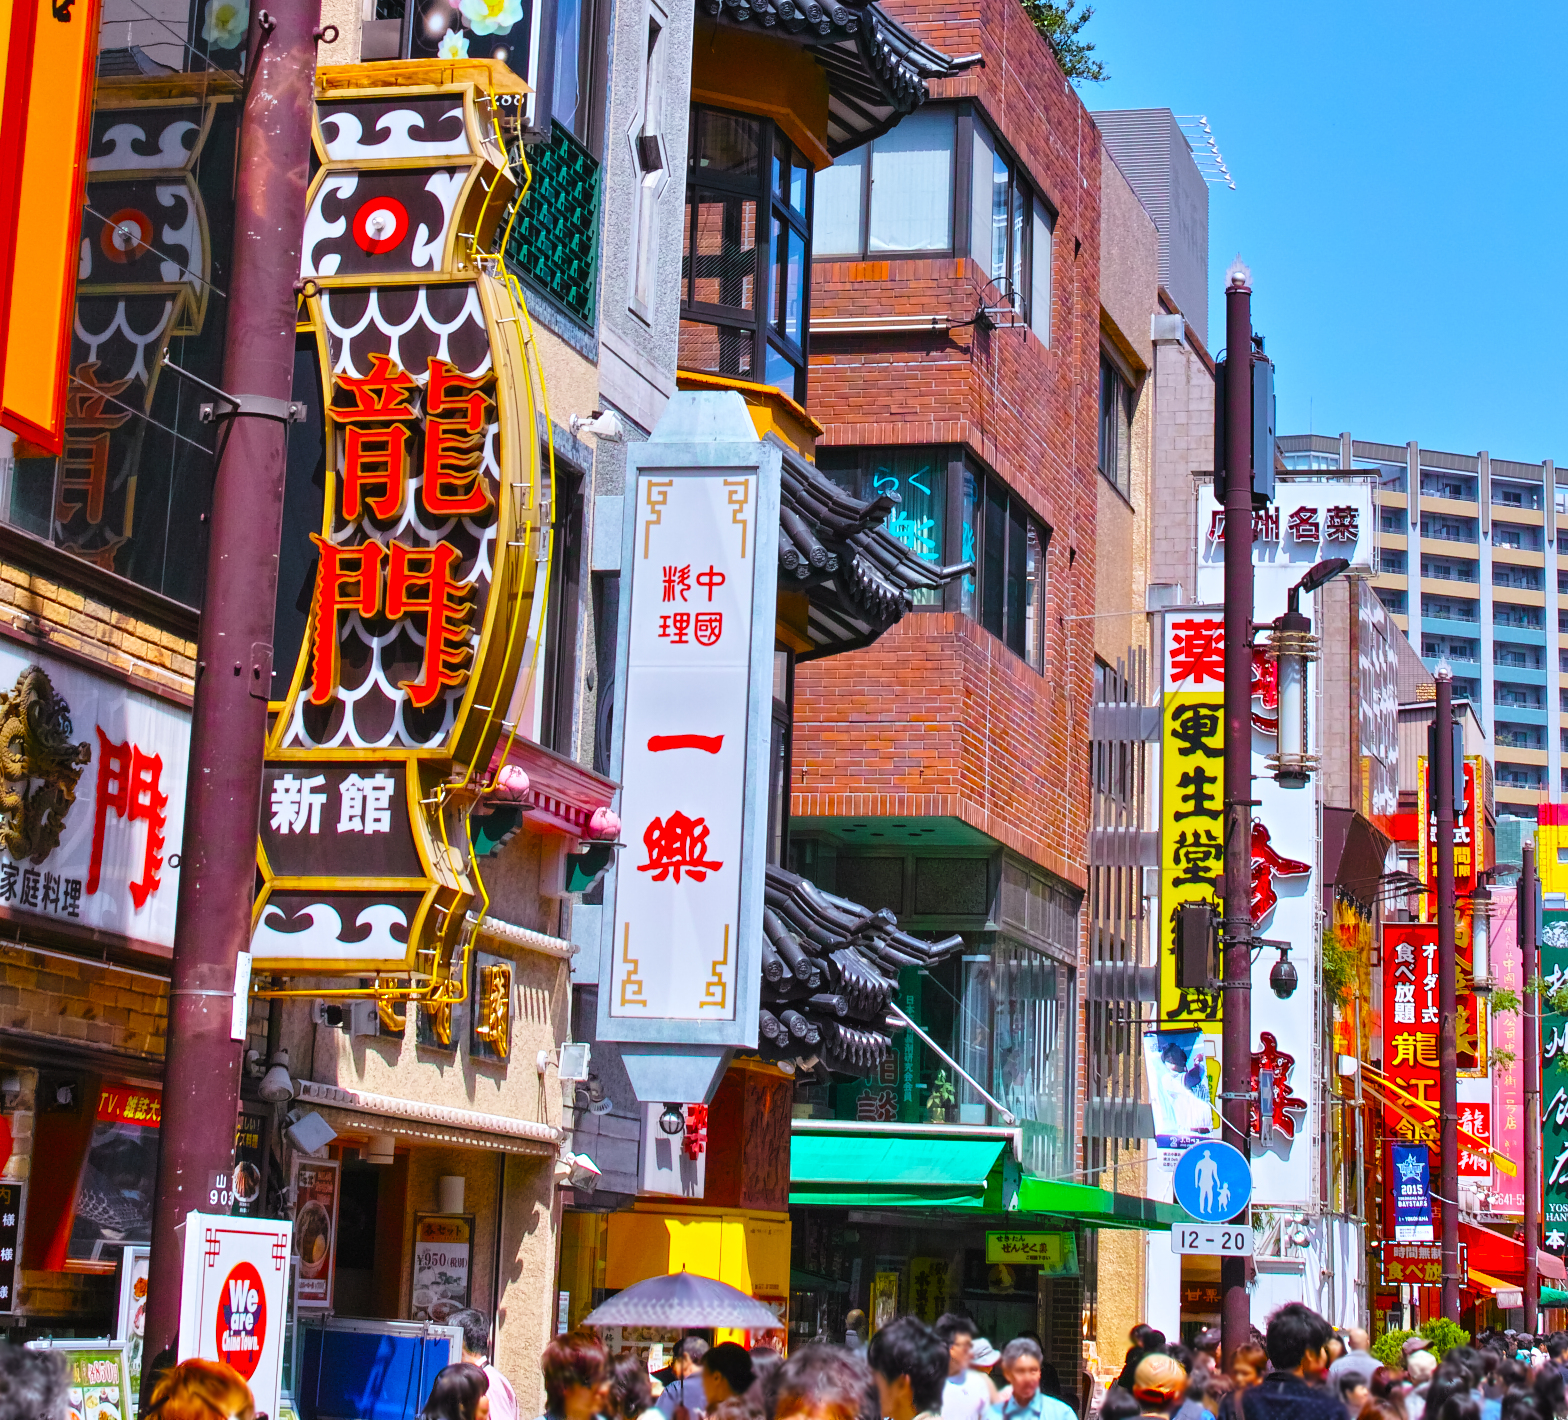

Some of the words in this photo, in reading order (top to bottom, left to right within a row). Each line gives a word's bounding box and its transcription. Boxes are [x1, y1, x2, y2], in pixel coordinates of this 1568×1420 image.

[310, 352, 499, 708] 龍門
[658, 565, 692, 646] 料理
[695, 565, 728, 646] 中國
[270, 774, 396, 835] 新館
[1394, 942, 1415, 1024] 食べ放題
[97, 1091, 162, 1122] TV、雑誌大
[215, 1174, 227, 1187] 山
[1401, 1184, 1423, 1195] 2015
[2, 1213, 16, 1227] 様
[0, 1247, 14, 1262] 様
[229, 1279, 259, 1313] We
[230, 1311, 255, 1330] are
